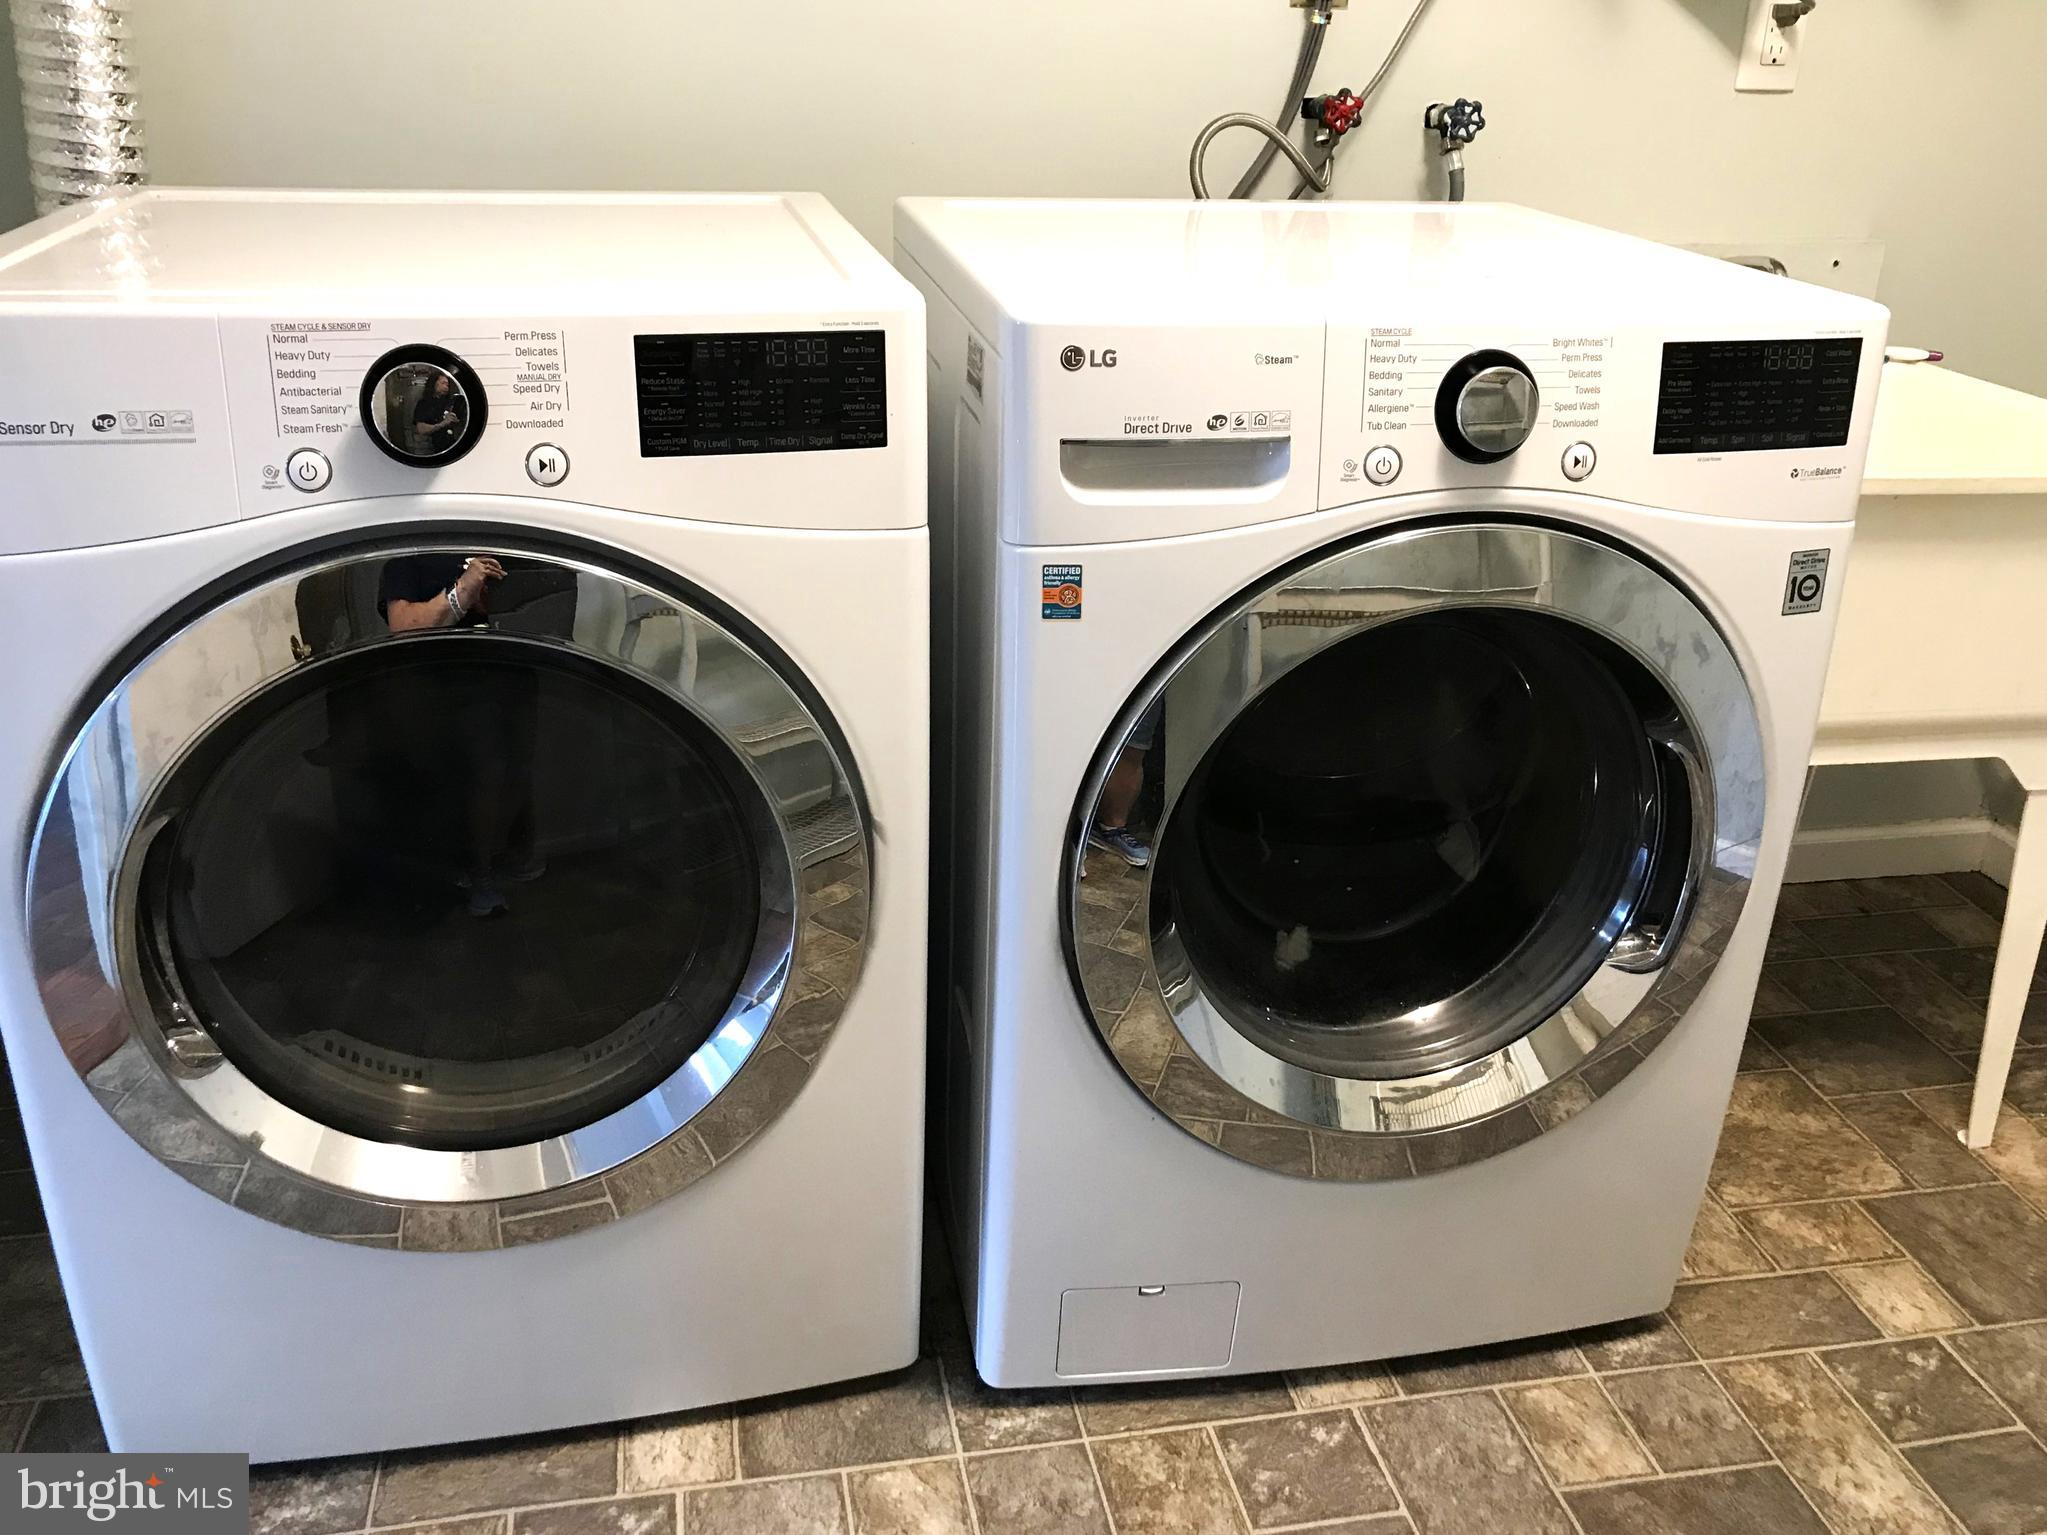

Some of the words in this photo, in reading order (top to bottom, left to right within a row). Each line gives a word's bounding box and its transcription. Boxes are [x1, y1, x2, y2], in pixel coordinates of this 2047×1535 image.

[271, 323, 297, 331] STEAM
[272, 334, 308, 344] Normal
[531, 331, 556, 340] Press
[1371, 339, 1400, 348] Normal
[1553, 338, 1576, 348] Bright
[275, 351, 306, 361] Heavy
[308, 351, 331, 361] Duty
[515, 347, 558, 357] Delicates
[1090, 350, 1117, 367] LG
[1370, 355, 1396, 364] Heavy
[1398, 354, 1417, 363] Duty
[1583, 353, 1602, 362] Press
[526, 362, 559, 371] Towels
[277, 369, 316, 379] Bedding
[1369, 371, 1402, 380] Bedding
[1568, 370, 1602, 378] Delicates
[280, 387, 342, 397] Antibacterial
[513, 384, 540, 394] Speed
[542, 384, 560, 394] Dry
[1368, 388, 1403, 397] Sanitary
[1575, 386, 1601, 394] Towels
[281, 405, 309, 414] Steam
[531, 401, 543, 411] Air
[545, 401, 562, 412] Dry
[1554, 402, 1577, 411] Speed
[1579, 402, 1599, 411] Wash
[506, 419, 564, 428] Downloaded
[1124, 423, 1159, 434] Direct
[1162, 422, 1192, 433] Drive
[1368, 422, 1382, 430] Tub
[1384, 421, 1407, 430] Clean
[1552, 419, 1598, 428] Downloaded
[0, 422, 46, 435] Sensor
[51, 422, 74, 437] Dry
[283, 424, 314, 434] Steam
[694, 439, 707, 449] Dry
[708, 438, 728, 448] Level
[809, 437, 833, 446] Signal
[1789, 574, 1820, 603] 10
